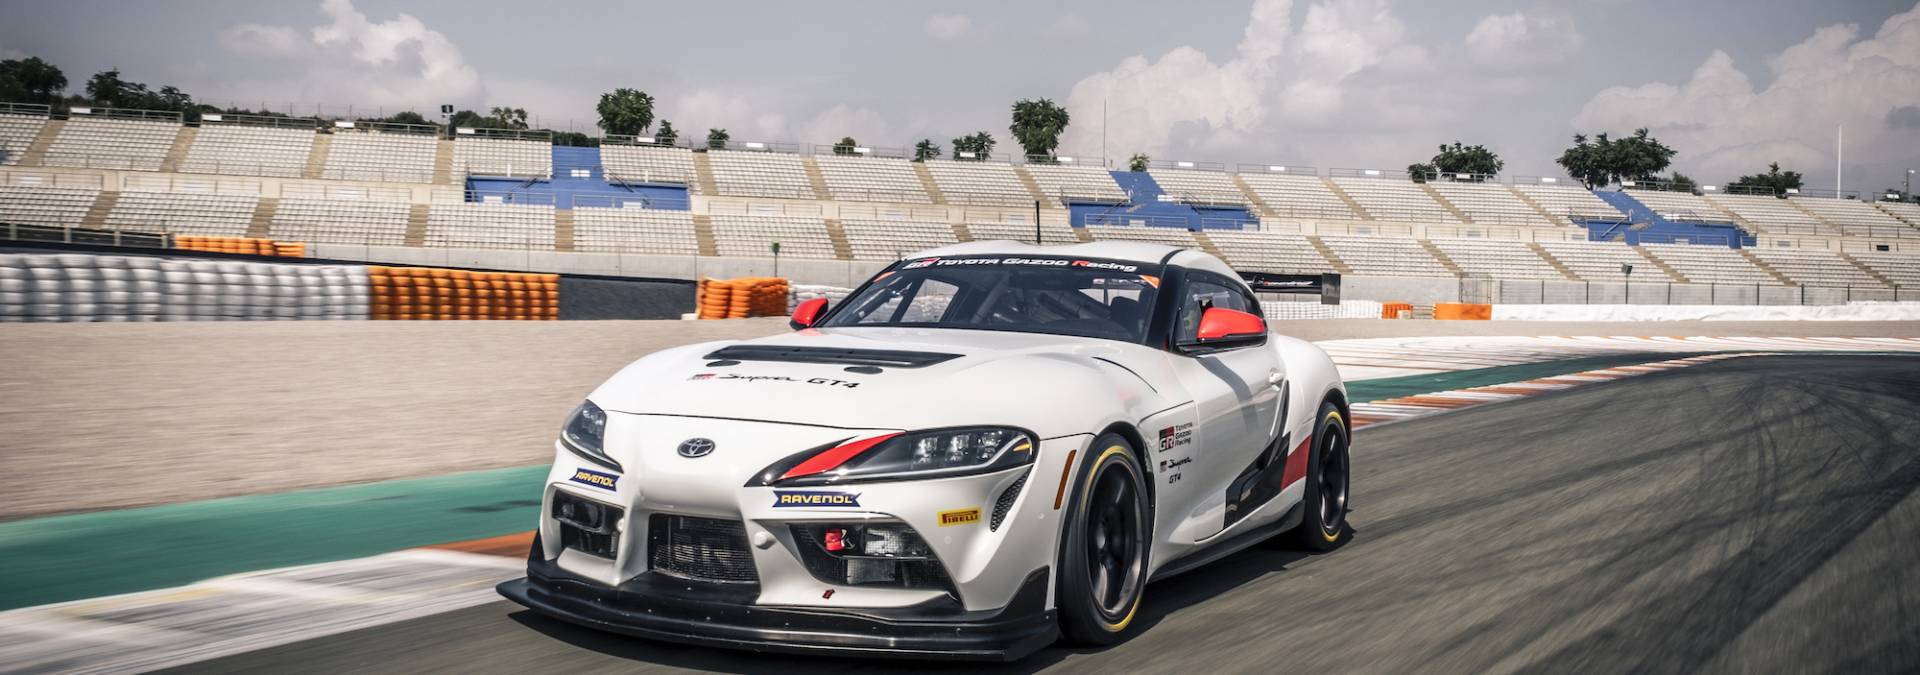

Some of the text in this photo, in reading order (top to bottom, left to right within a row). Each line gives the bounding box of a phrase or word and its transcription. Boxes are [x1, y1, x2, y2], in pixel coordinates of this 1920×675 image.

[936, 258, 1000, 266] TOYOTA
[1002, 258, 1069, 267] GAZOO
[1072, 260, 1138, 272] Racing
[806, 377, 861, 389] GT4
[1159, 438, 1174, 453] GR
[575, 471, 614, 486] RAVENOL
[1169, 473, 1182, 484] GT4
[781, 494, 854, 504] RAVENOL
[942, 510, 979, 523] PIRELLI
